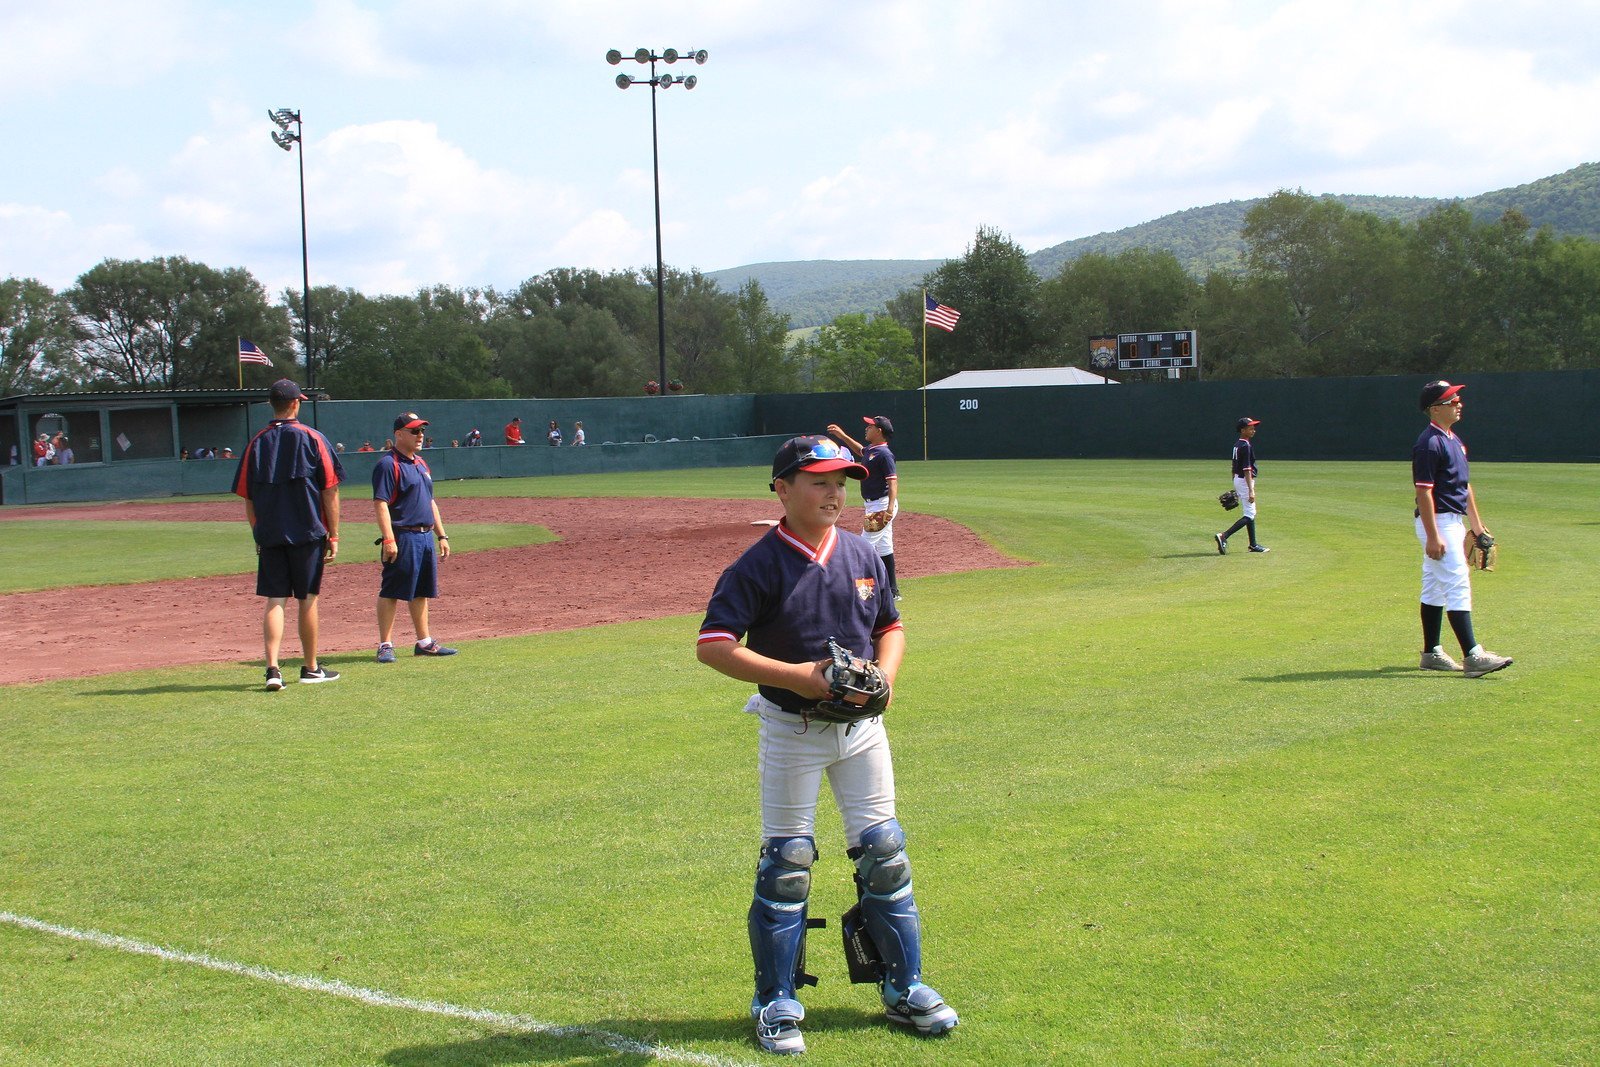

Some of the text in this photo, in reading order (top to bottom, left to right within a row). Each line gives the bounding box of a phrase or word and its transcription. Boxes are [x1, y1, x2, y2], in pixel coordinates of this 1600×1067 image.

[1147, 334, 1163, 342] INNING
[1175, 333, 1188, 341] HOME
[959, 399, 979, 410] 200
